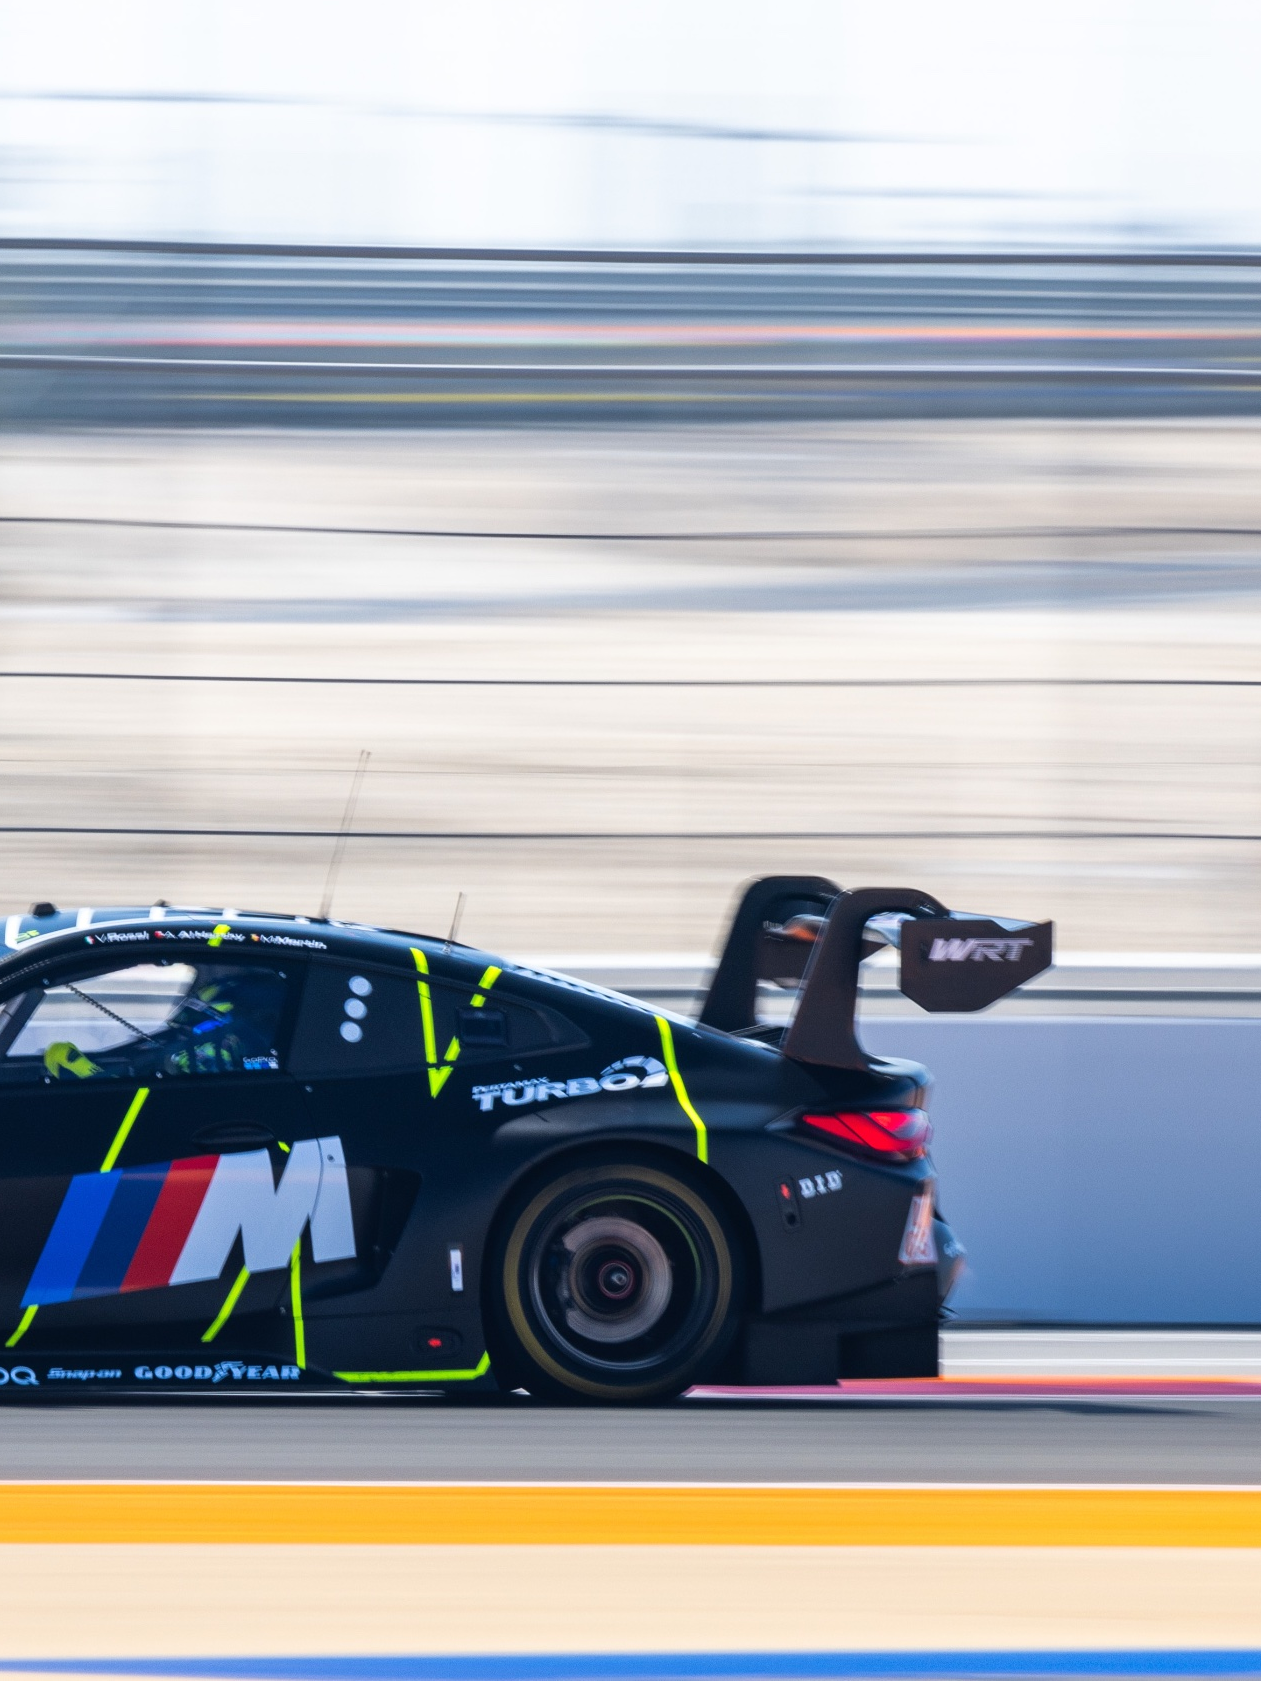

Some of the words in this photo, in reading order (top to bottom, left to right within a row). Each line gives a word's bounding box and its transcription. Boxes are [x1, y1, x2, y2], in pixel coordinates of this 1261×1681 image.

[928, 937, 1034, 962] WRT
[168, 1135, 357, 1287] M
[46, 1367, 122, 1381] Snap-on
[134, 1360, 302, 1384] GOODYEAR
